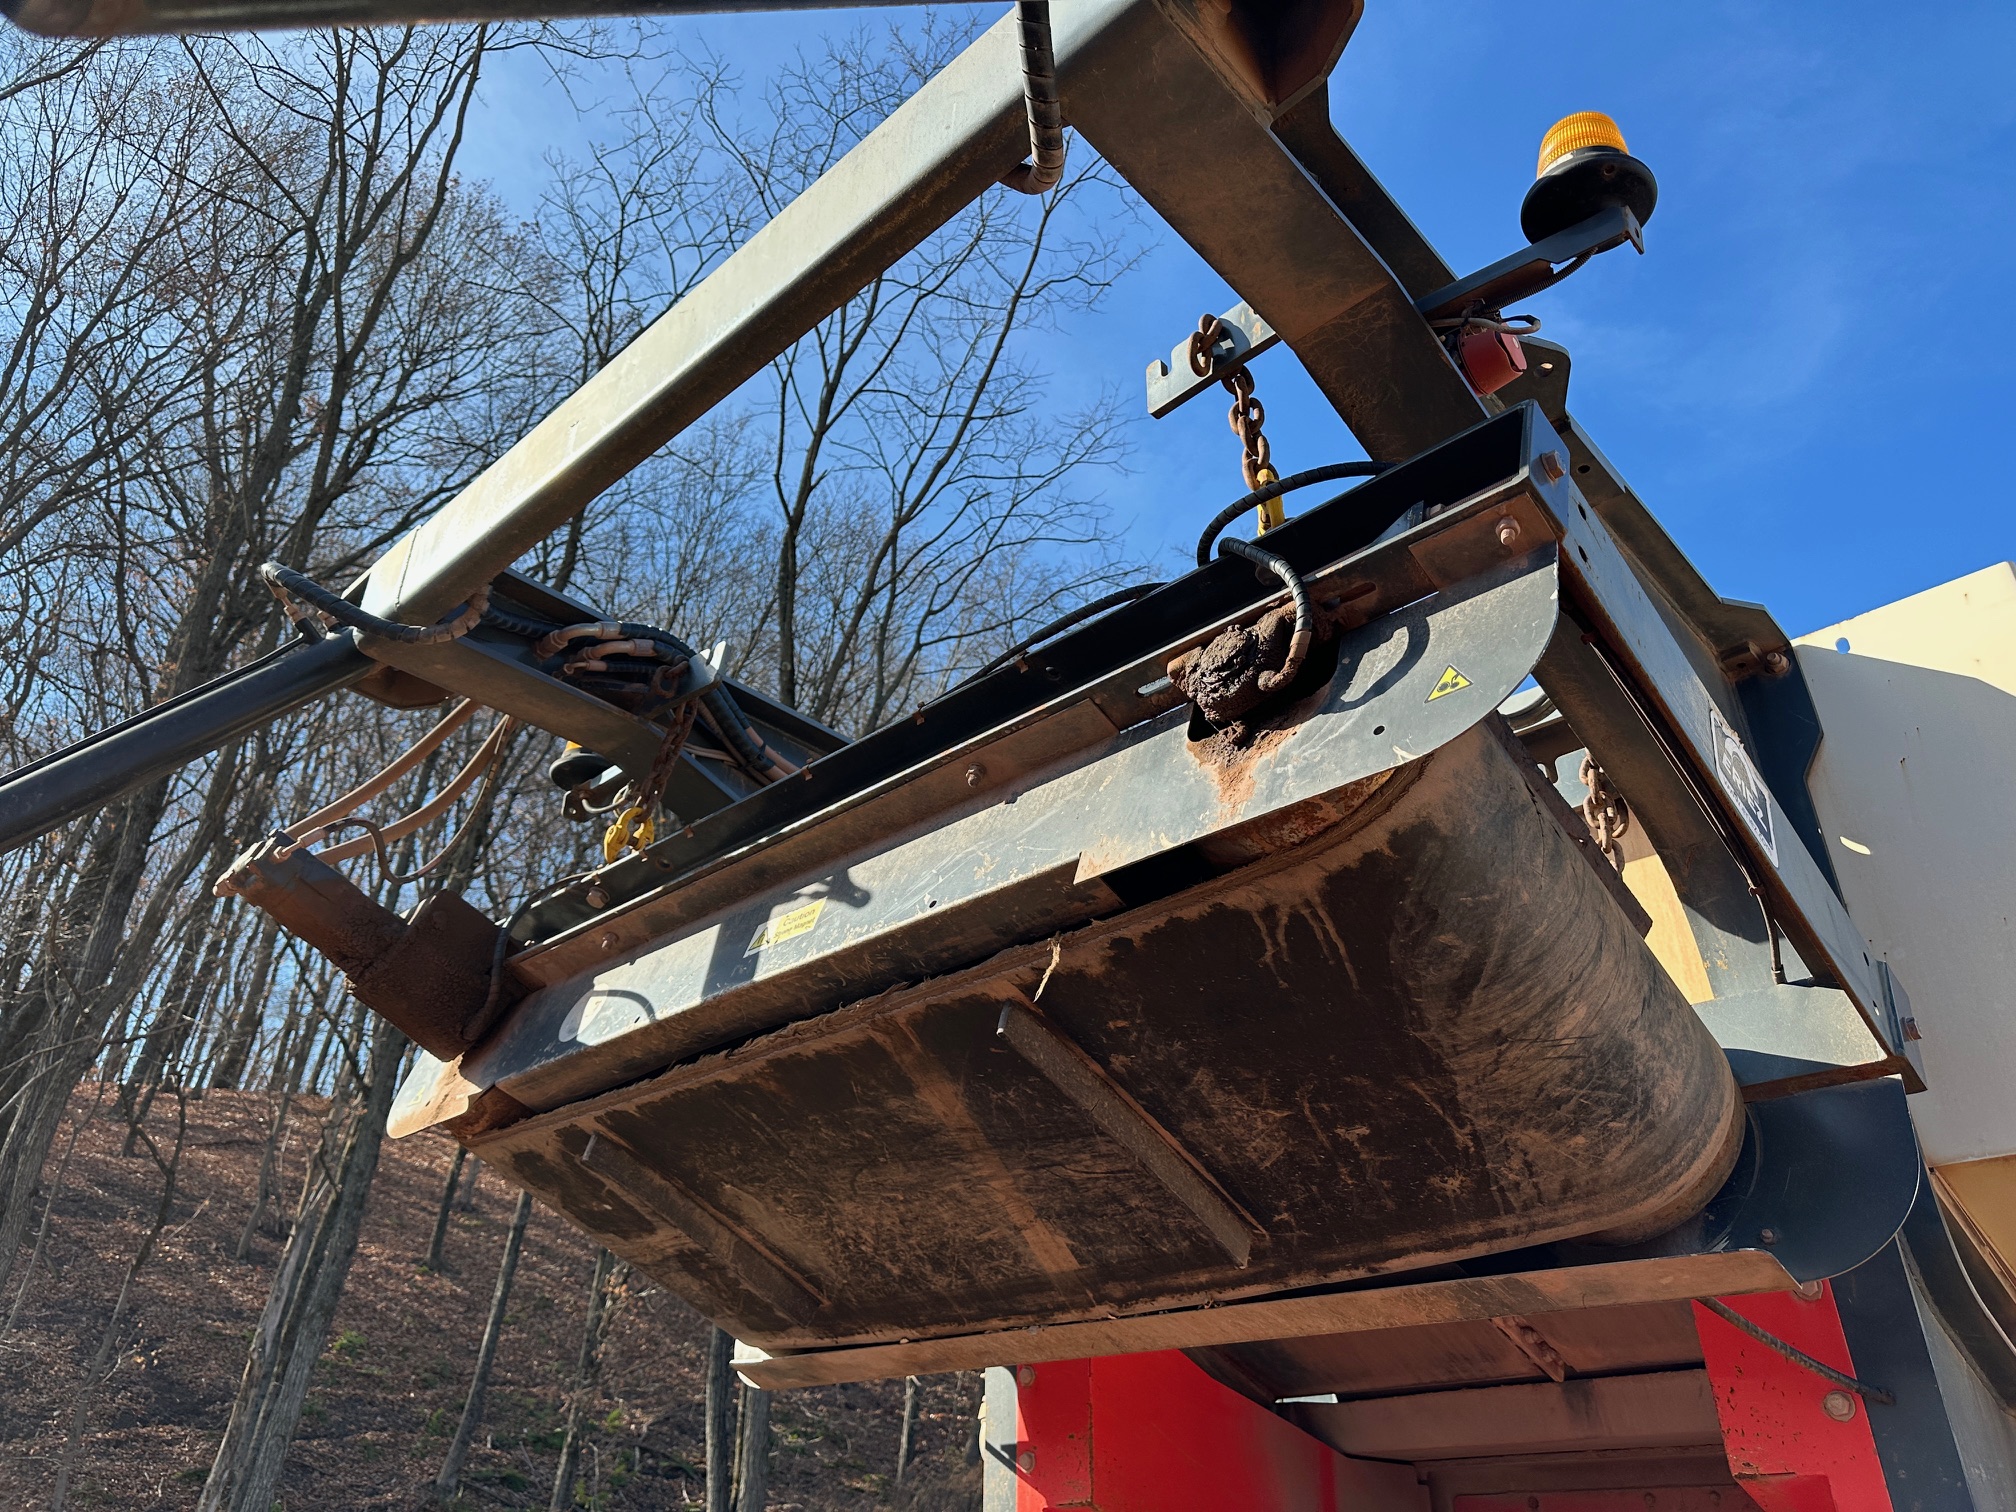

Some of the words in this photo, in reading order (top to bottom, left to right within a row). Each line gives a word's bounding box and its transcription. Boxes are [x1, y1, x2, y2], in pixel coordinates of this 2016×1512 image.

[1722, 751, 1768, 832] ERIEZ
[783, 908, 816, 926] Caution
[794, 916, 816, 930] Magnet
